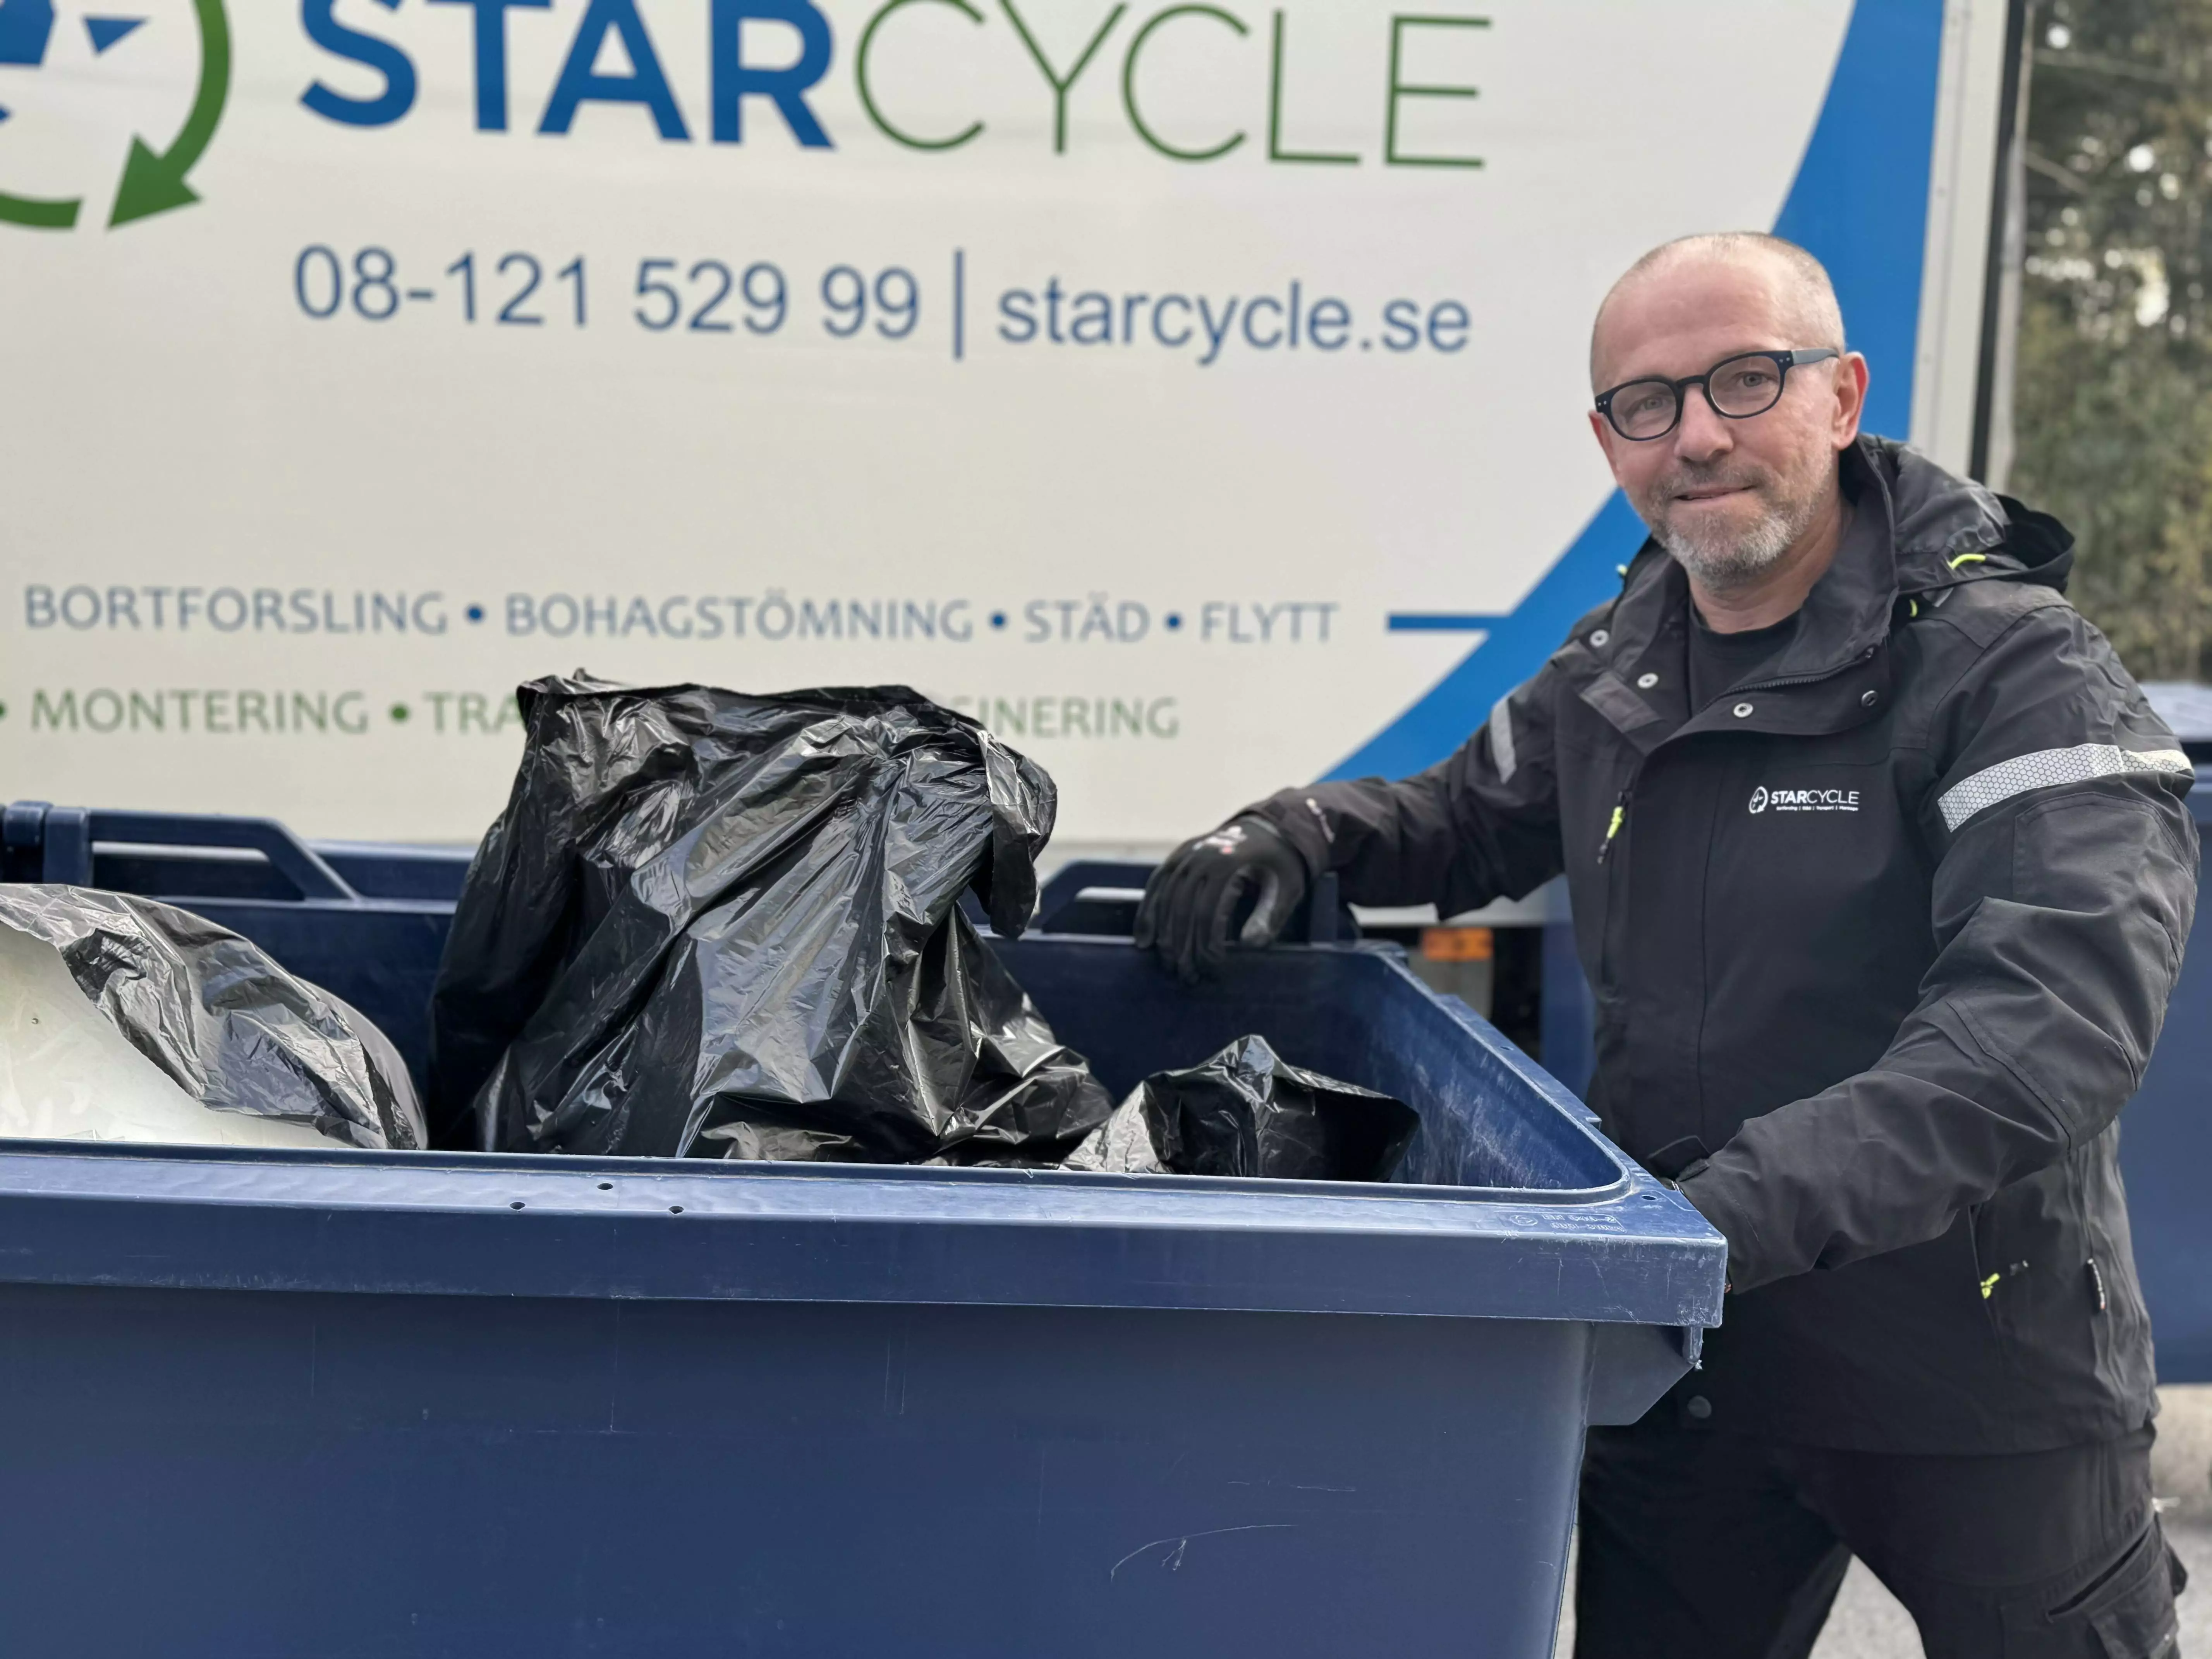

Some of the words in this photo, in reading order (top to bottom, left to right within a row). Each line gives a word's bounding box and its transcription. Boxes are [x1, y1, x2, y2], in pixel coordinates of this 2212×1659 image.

[297, 0, 1490, 169] STARCYCLE
[294, 244, 586, 328] 08-121
[634, 257, 788, 335] 529
[819, 264, 920, 340] 99
[998, 280, 1471, 367] starcycle.se
[24, 584, 448, 634] BORTFORSLING
[503, 588, 974, 642] BOHAGSTÖMNING
[1024, 592, 1150, 644] STÄD
[1199, 601, 1338, 644] FLYTT
[30, 687, 369, 734] MONTERING
[1771, 789, 1860, 805] STARCYCLE
